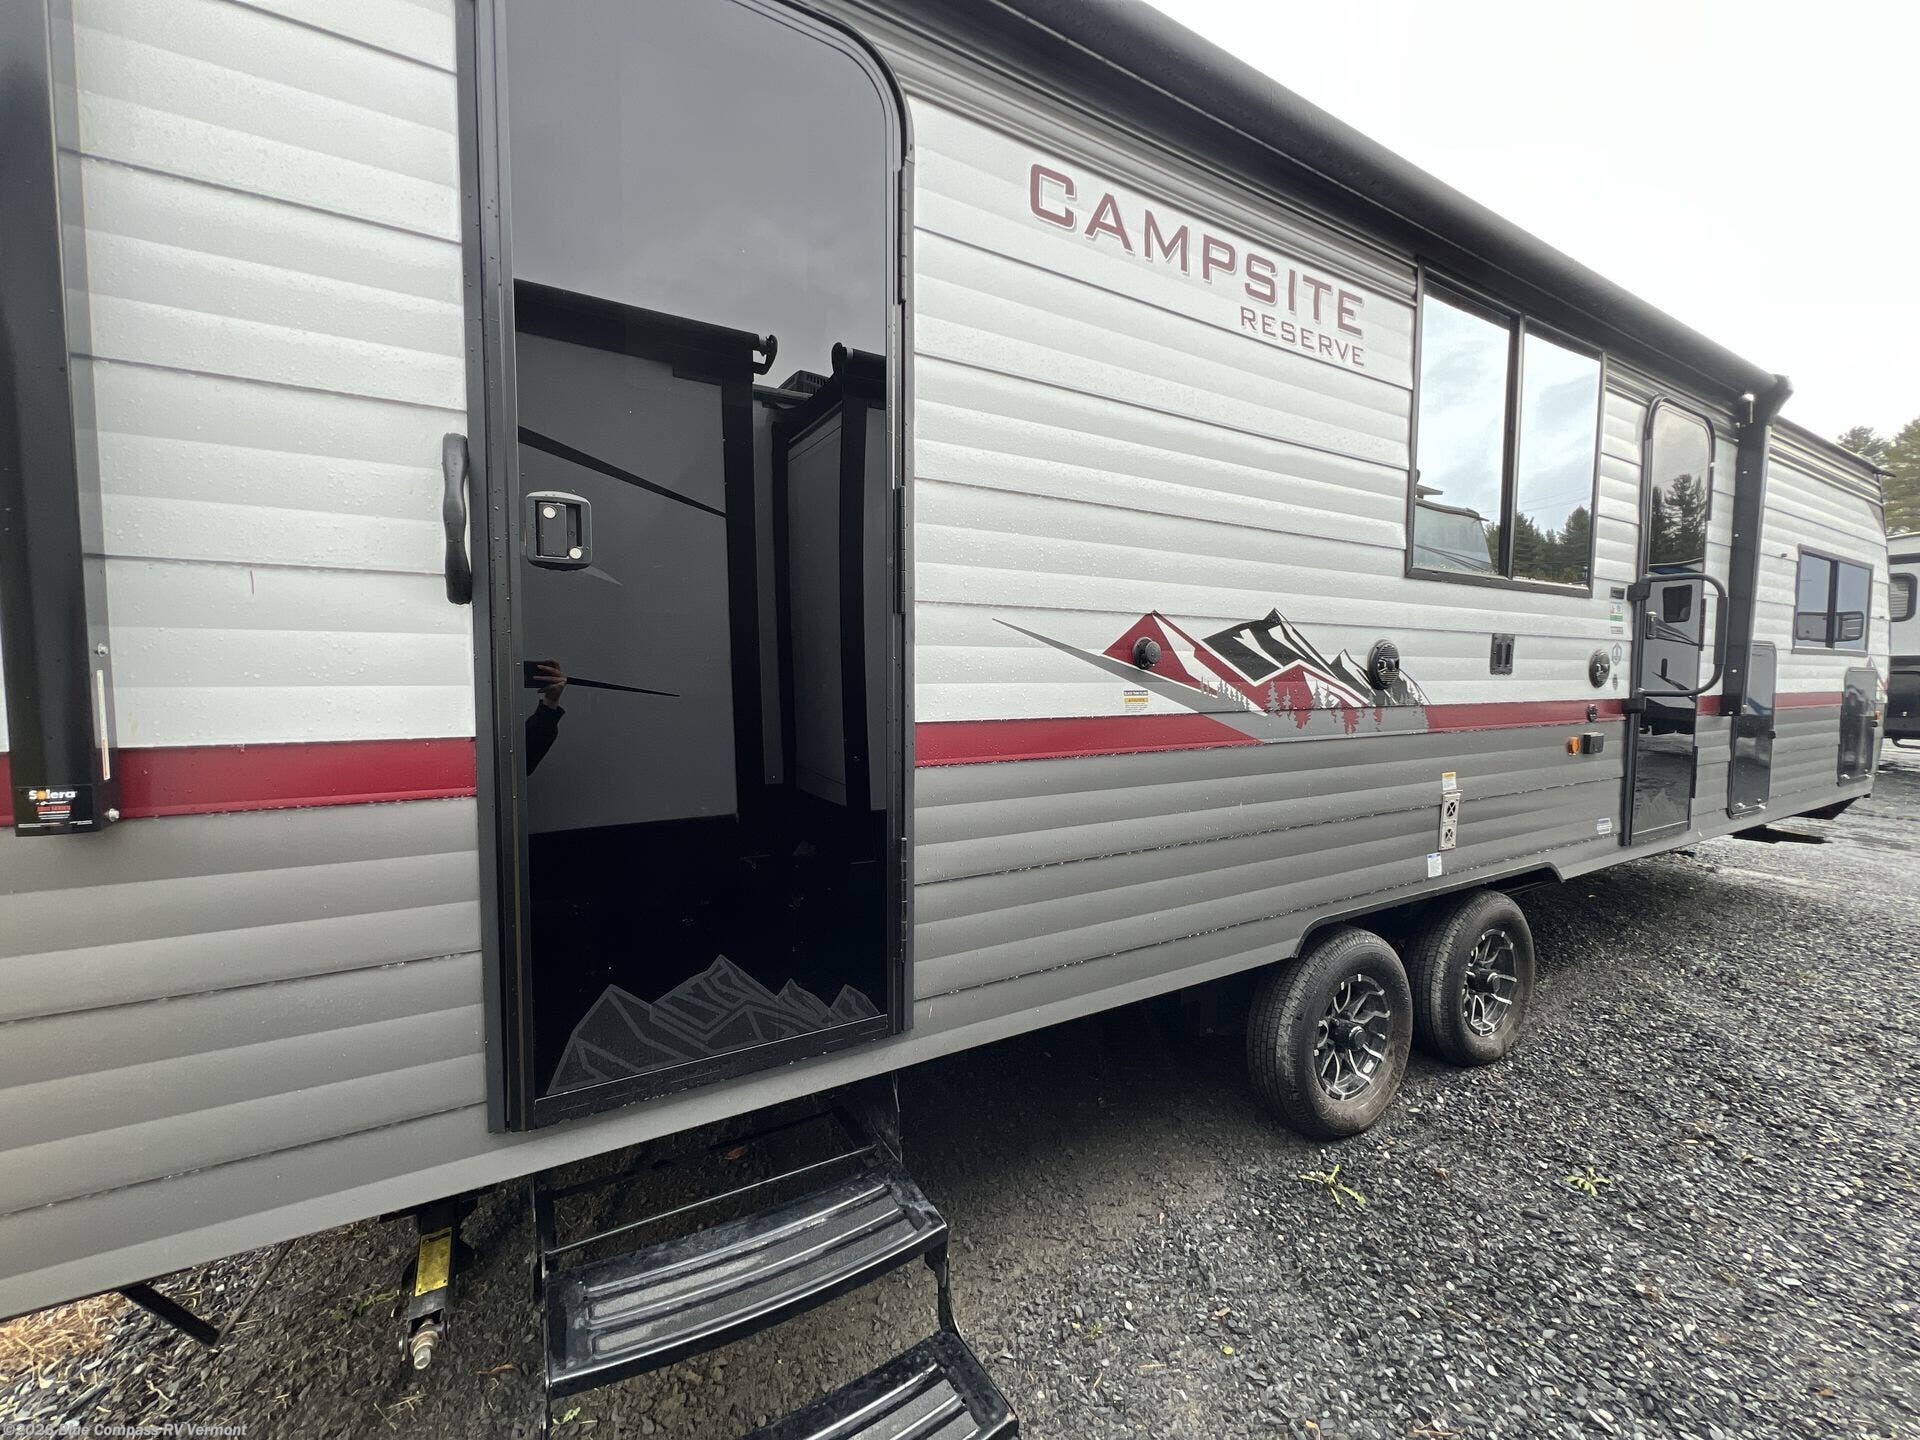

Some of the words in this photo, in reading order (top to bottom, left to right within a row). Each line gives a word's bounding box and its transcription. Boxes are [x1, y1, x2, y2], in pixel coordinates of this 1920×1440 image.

[1029, 163, 1365, 338] CAMPSITE
[1240, 306, 1366, 368] RESERVE
[28, 788, 77, 801] Solera
